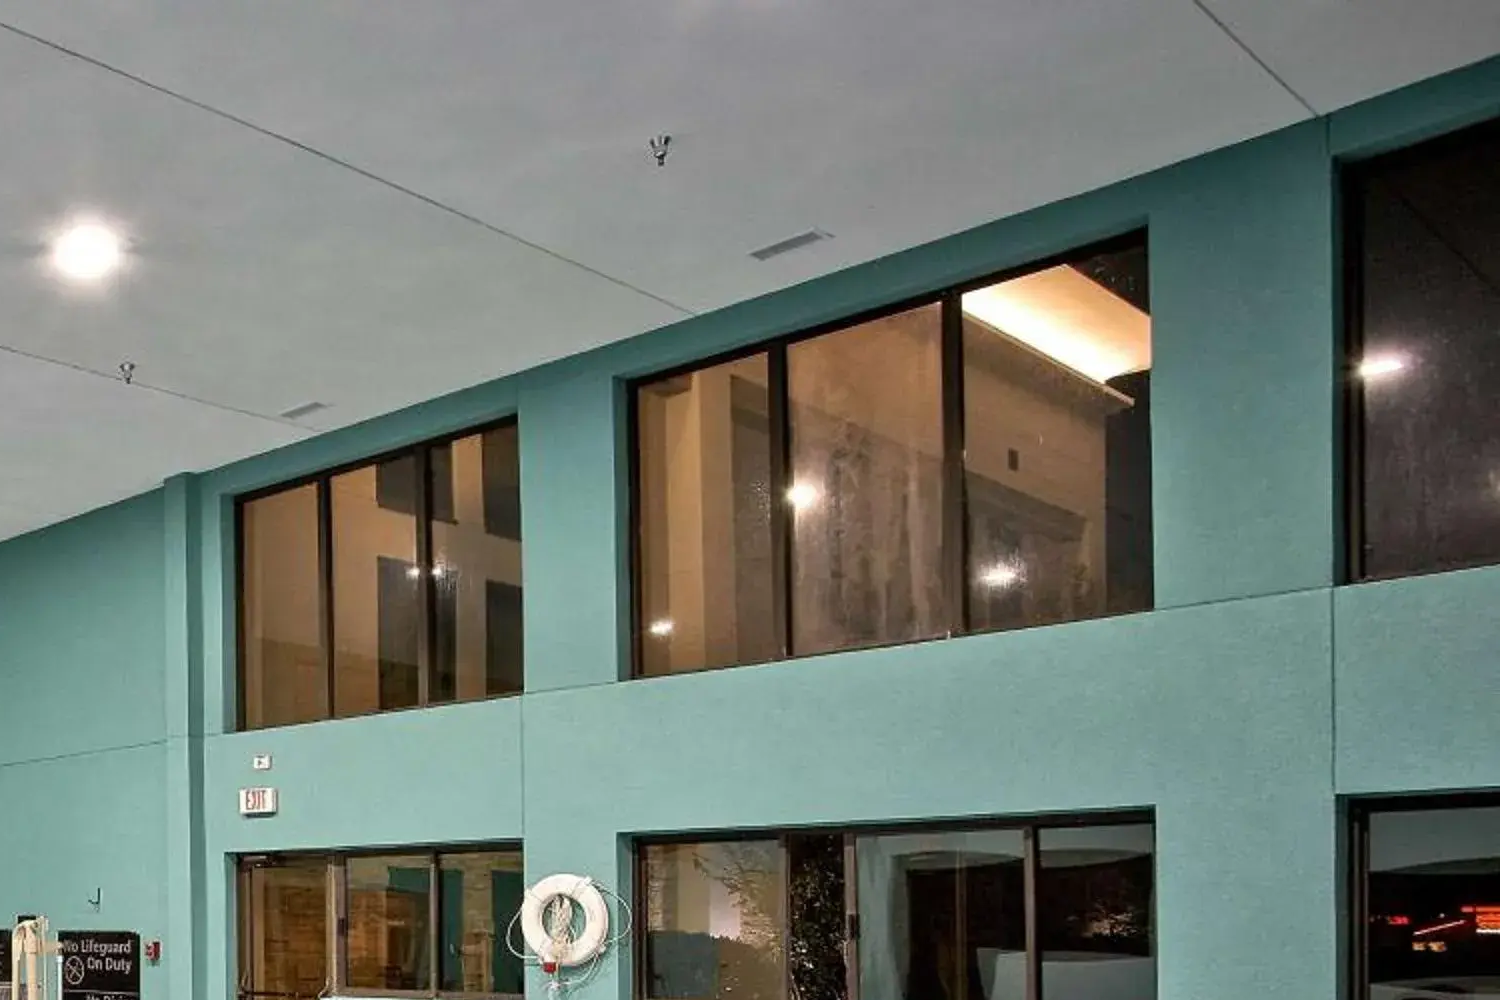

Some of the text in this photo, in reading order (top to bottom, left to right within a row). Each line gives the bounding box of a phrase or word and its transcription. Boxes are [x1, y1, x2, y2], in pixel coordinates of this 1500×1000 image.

[245, 790, 266, 810] EXIT
[81, 938, 131, 957] Lifeguard
[87, 957, 132, 975] On Duty
